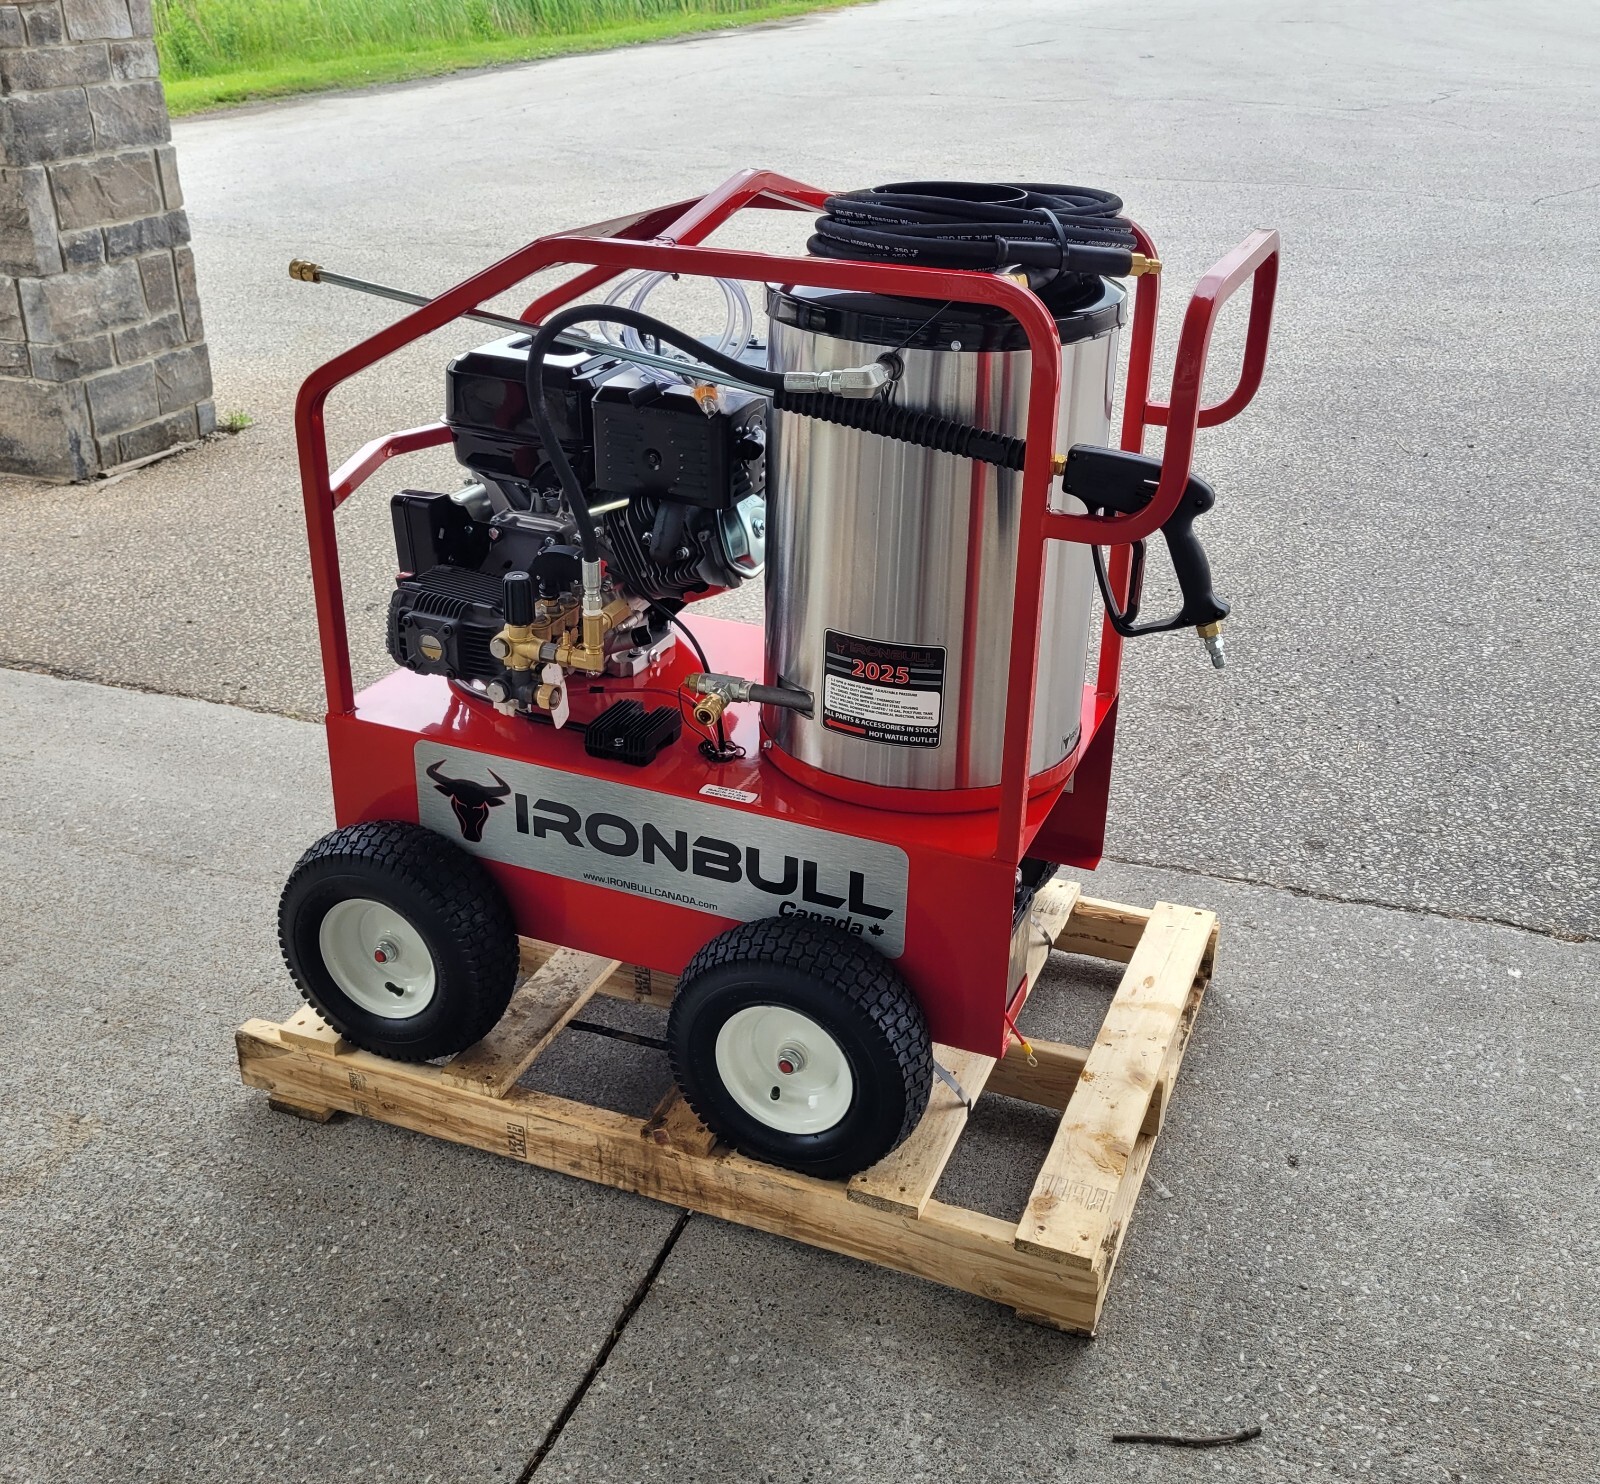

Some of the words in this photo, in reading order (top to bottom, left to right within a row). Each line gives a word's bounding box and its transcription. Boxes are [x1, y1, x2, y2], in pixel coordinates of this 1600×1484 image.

[867, 214, 899, 224] Pressure
[849, 641, 937, 664] IRONBULL
[851, 659, 910, 684] 2025
[824, 709, 835, 718] ALL
[835, 712, 854, 723] PARTS
[860, 719, 905, 732] ACCESSORIES
[906, 725, 914, 733] IN
[915, 726, 938, 734] STOCK
[868, 730, 884, 738] HOT
[884, 733, 909, 742] WATER
[909, 736, 938, 744] OUTLET
[514, 793, 894, 921] IRONBULL
[582, 872, 718, 911] www.IRONBULLCANADA.com
[778, 901, 865, 936] Canada
[508, 1134, 518, 1153] 121
[516, 1139, 525, 1154] HT
